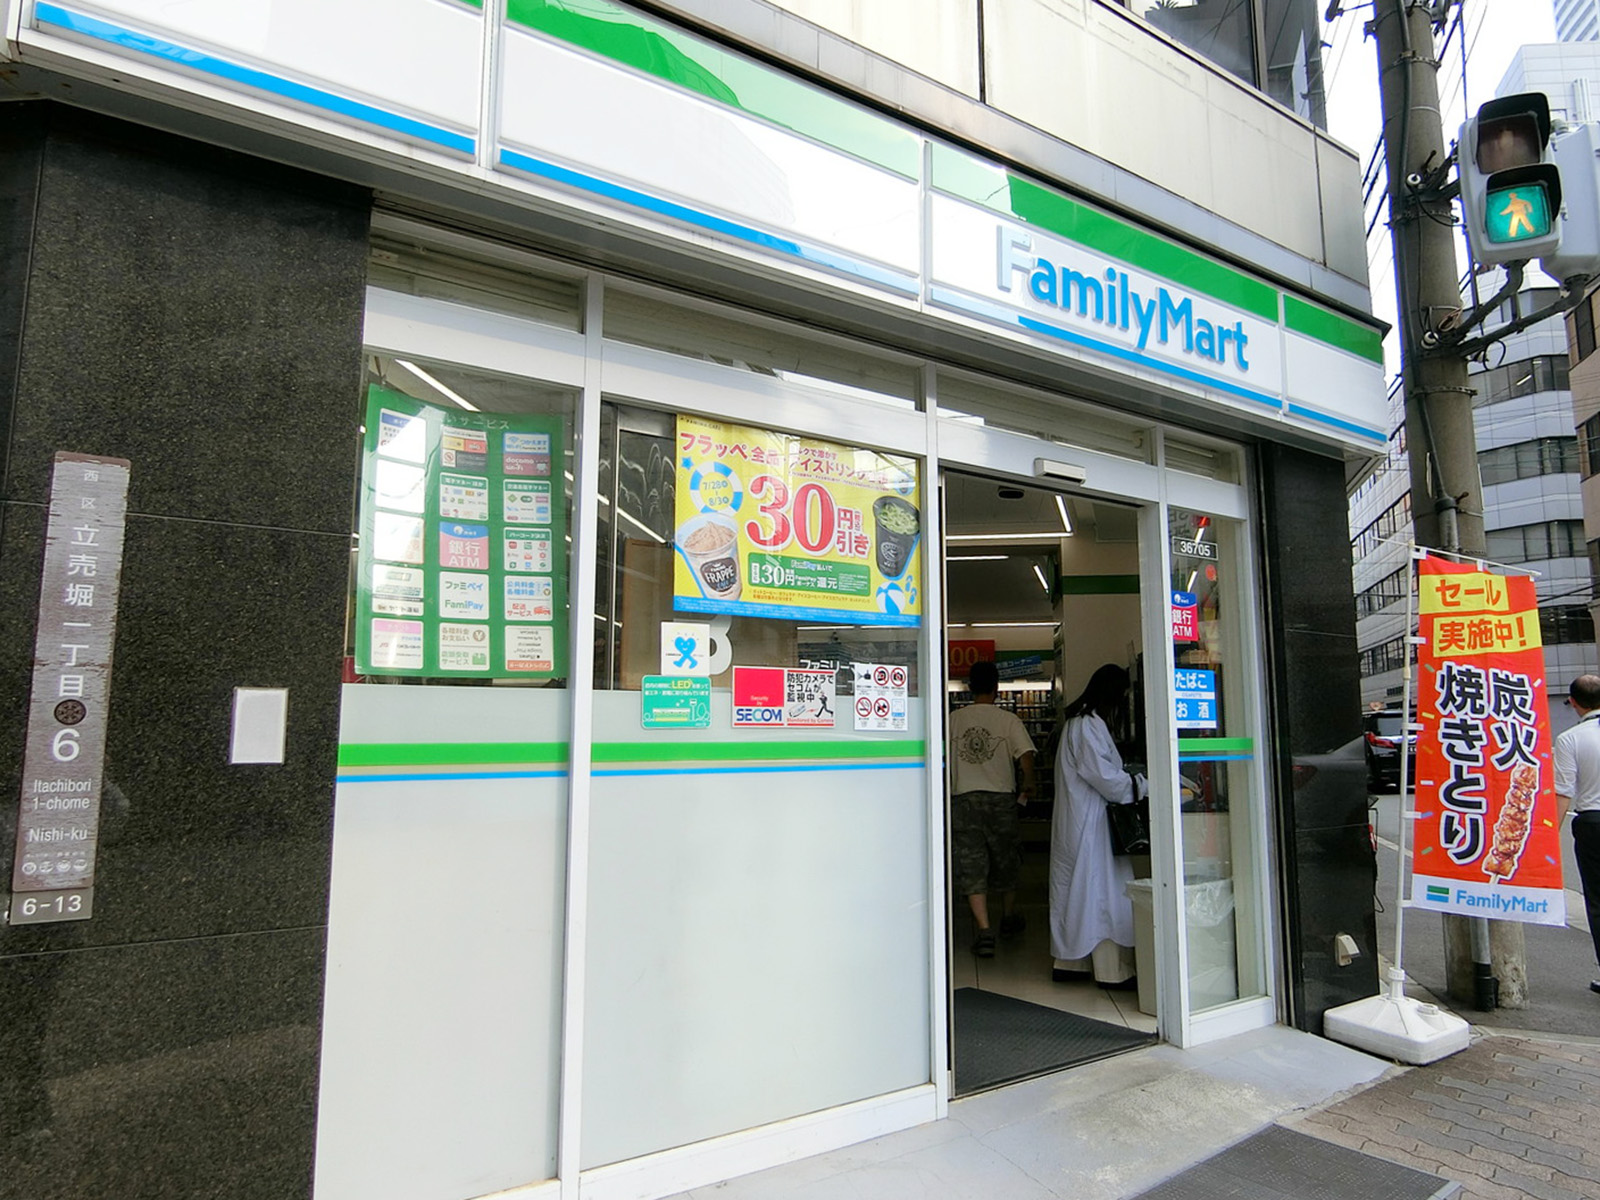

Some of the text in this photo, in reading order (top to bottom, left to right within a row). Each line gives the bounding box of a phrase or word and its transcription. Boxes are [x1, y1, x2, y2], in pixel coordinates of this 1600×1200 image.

[996, 224, 1249, 373] FamilyMart
[448, 539, 481, 556] 銀行
[1180, 541, 1211, 556] 36705
[448, 555, 480, 568] ATM
[58, 468, 100, 697] 西区 立売堀一丁目
[1435, 579, 1502, 608] セール
[444, 600, 485, 611] FamiPay
[507, 609, 532, 617] サービス
[1172, 609, 1192, 626] 銀行
[1173, 625, 1193, 637] ATM
[442, 658, 470, 666] サービス
[671, 679, 692, 689] LED
[787, 672, 834, 685] 防犯カメラで
[1175, 671, 1208, 689] たばこ
[787, 683, 822, 693] セコムが
[787, 692, 815, 703] 監視中
[736, 708, 782, 722] SECOM
[1176, 701, 1210, 719] お酒
[1489, 669, 1541, 768] 炭火
[52, 728, 81, 762] 6
[1436, 662, 1488, 863] 焼きとり
[33, 778, 92, 793] Itachibori
[33, 796, 91, 810] 1-chome
[28, 827, 88, 842] Nishi-ku
[22, 895, 82, 916] 6-13
[1455, 888, 1549, 914] FamilyMart
